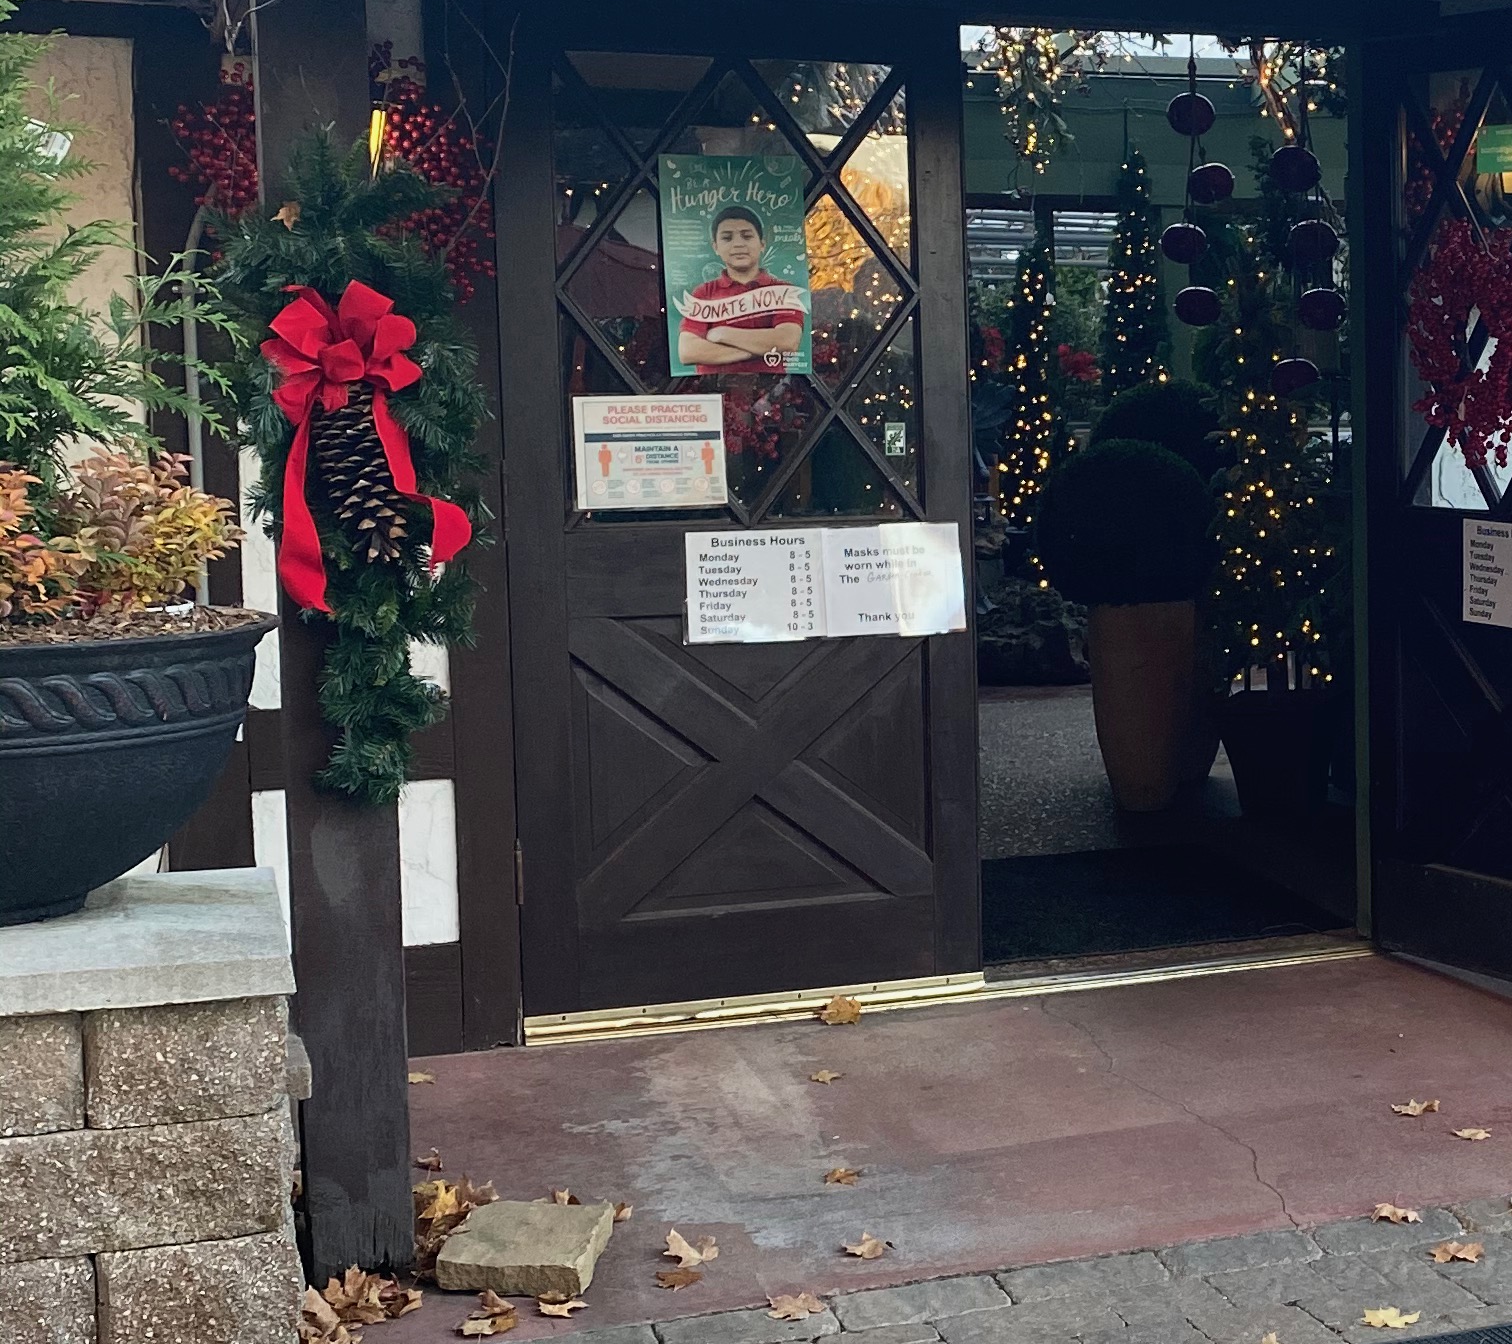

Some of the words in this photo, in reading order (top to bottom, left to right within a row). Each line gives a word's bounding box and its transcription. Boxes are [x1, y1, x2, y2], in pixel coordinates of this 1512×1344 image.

[670, 185, 741, 214] Hunger
[745, 181, 791, 210] Hero
[689, 297, 747, 319] DONATE
[752, 288, 789, 309] NOW
[607, 405, 647, 415] PLEASE
[650, 404, 702, 414] PRACTICE
[602, 415, 641, 425] SOCIAL
[645, 413, 708, 424] DISTANCING
[1477, 525, 1509, 539] Business
[710, 537, 766, 548] Business
[769, 536, 805, 545] Hours
[1470, 539, 1494, 552] Monday
[699, 553, 740, 563] Monday
[789, 551, 796, 559] 8
[805, 550, 811, 558] 5
[844, 548, 879, 558] Masks
[882, 546, 910, 556] must
[1470, 550, 1495, 564] Tuesday
[698, 565, 742, 575] Tuesday
[789, 563, 795, 571] 8
[804, 563, 810, 571] 5
[844, 562, 872, 571] worn
[875, 559, 904, 569] while
[1470, 562, 1505, 576] Wednesday
[698, 577, 759, 587] Wednesday
[790, 575, 797, 583] 8
[806, 575, 812, 583] 5
[839, 574, 860, 584] The
[1470, 573, 1498, 587] Thursday
[699, 589, 748, 599] Thursday
[791, 587, 798, 595] 8
[807, 587, 813, 595] 5
[1469, 585, 1488, 596] Friday
[699, 601, 732, 611] Friday
[790, 599, 797, 607] 8
[806, 598, 812, 607] 5
[1469, 596, 1496, 609] Saturday
[700, 613, 746, 623] Saturday
[792, 610, 799, 619] 8
[808, 610, 815, 618] 5
[858, 612, 892, 623] Thank
[894, 611, 915, 622] you
[787, 623, 798, 631] 10
[807, 623, 813, 631] 3
